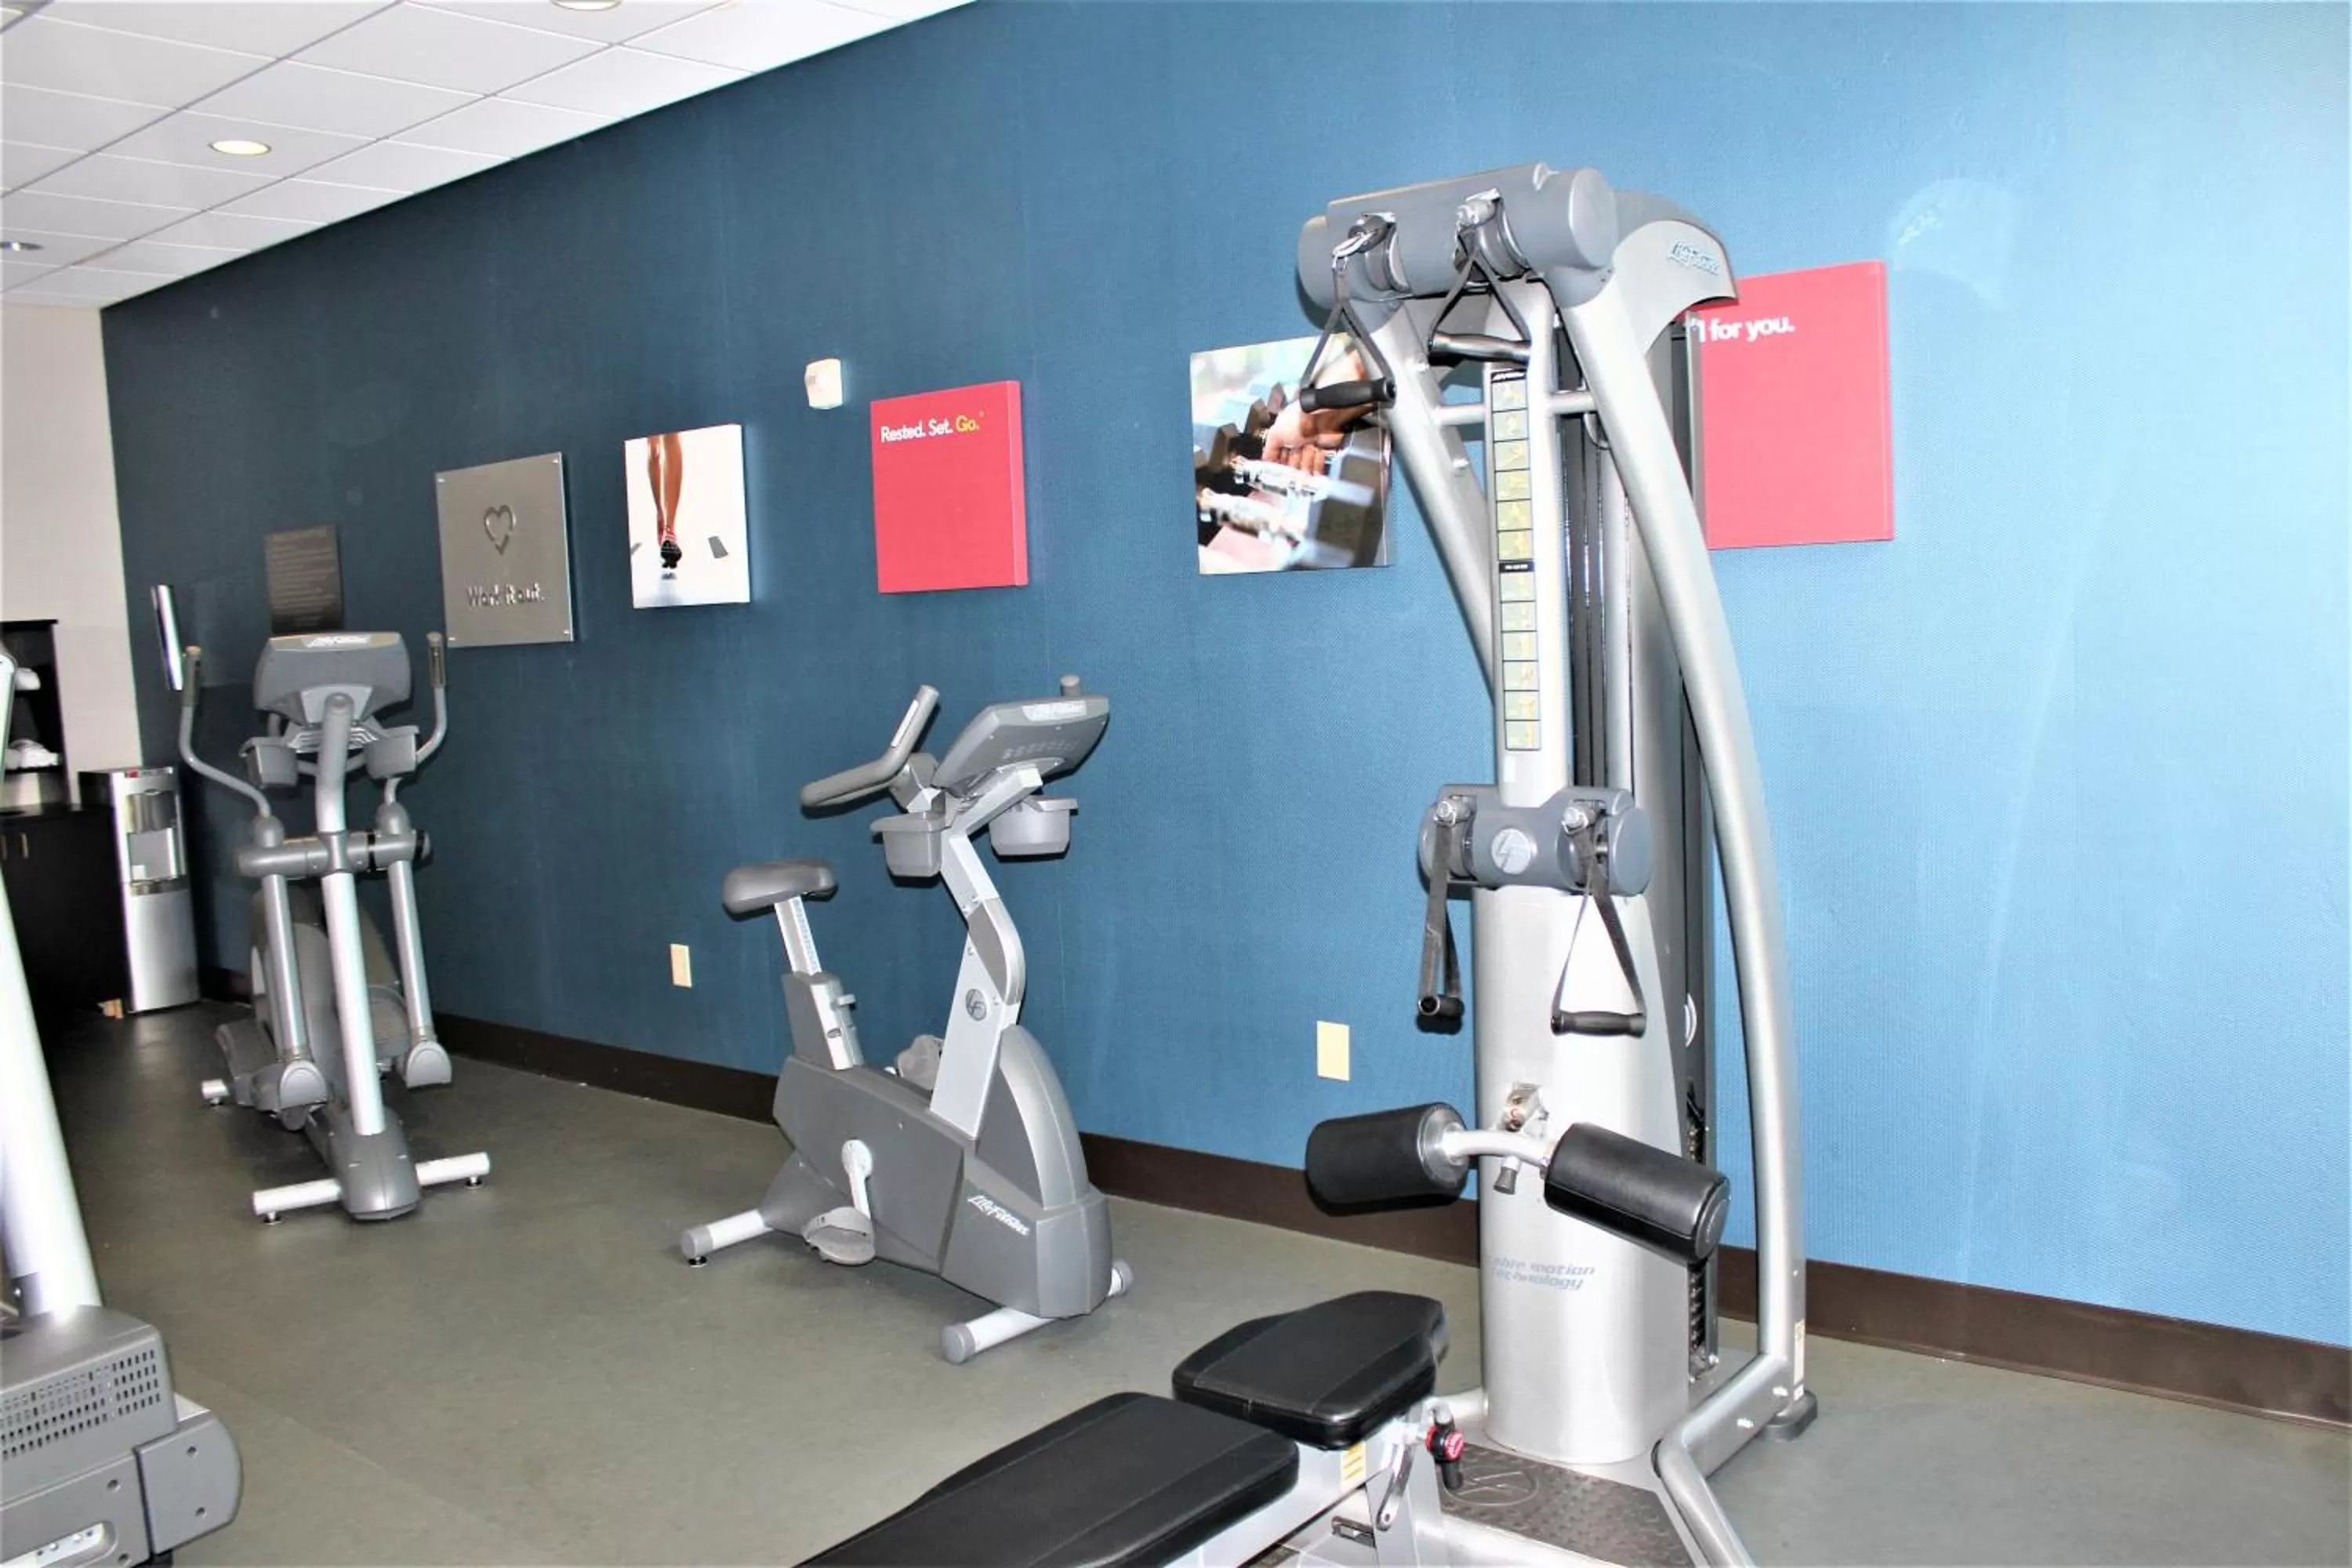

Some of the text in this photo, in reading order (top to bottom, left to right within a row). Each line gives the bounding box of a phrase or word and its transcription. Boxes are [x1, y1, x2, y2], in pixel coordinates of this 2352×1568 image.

[1710, 318, 1744, 342] for
[1745, 316, 1795, 342] you.
[880, 415, 979, 443] Rested. Set. Go.
